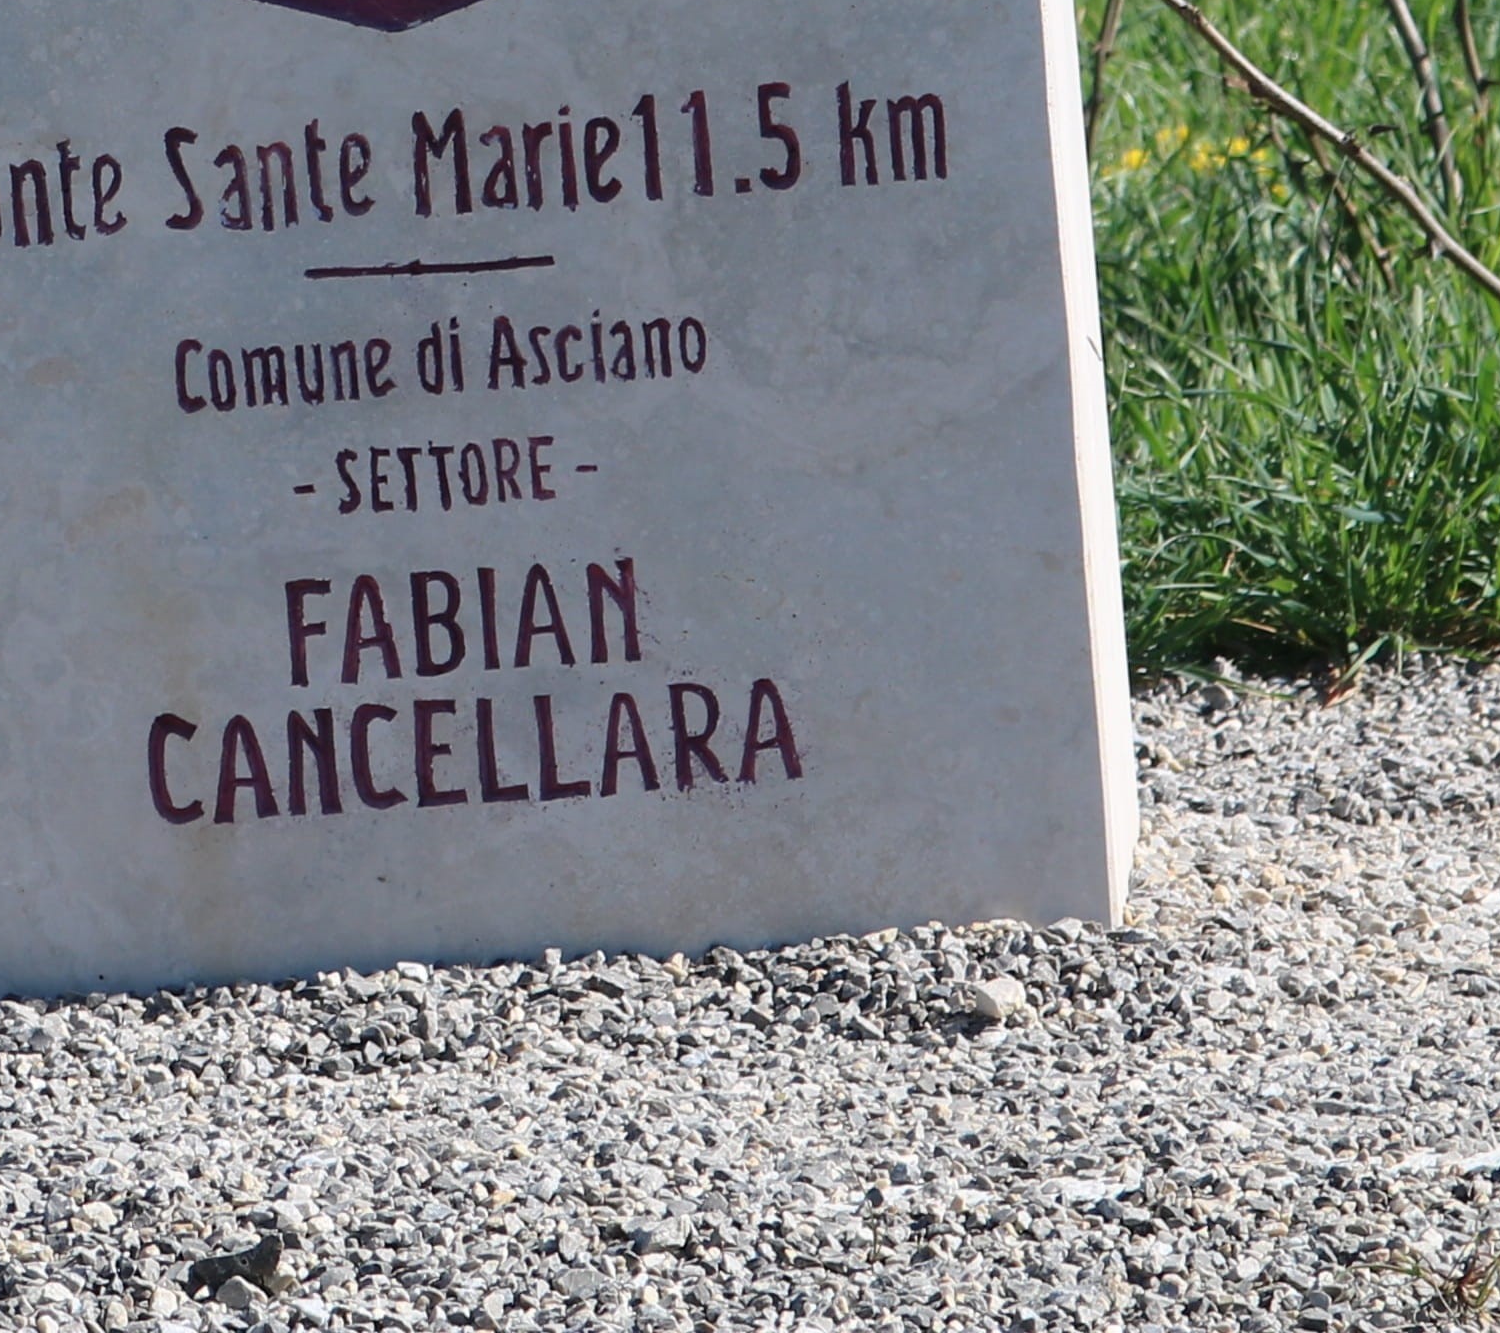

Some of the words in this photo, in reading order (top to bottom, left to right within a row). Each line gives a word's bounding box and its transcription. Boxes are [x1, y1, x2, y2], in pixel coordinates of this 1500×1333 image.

[165, 118, 376, 231] Sante
[836, 82, 948, 187] km
[176, 336, 396, 414] Comune
[420, 318, 464, 396] di
[488, 312, 707, 391] Asciano
[286, 557, 643, 687] FABIAN
[149, 676, 804, 825] CANCELLARA
